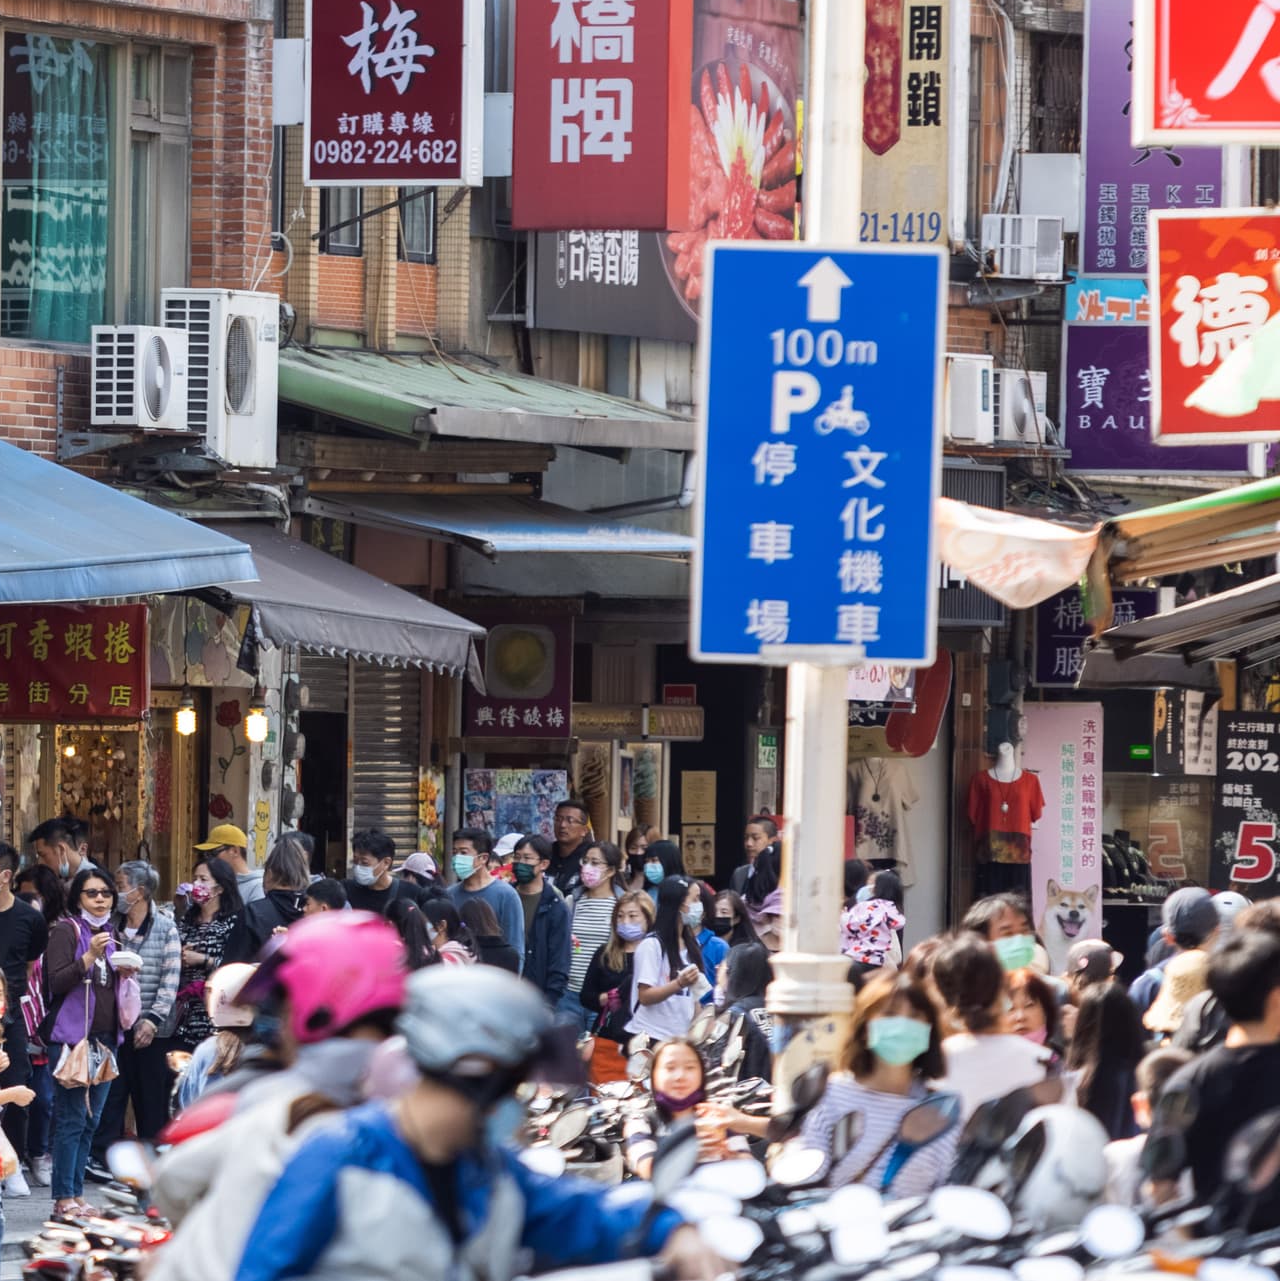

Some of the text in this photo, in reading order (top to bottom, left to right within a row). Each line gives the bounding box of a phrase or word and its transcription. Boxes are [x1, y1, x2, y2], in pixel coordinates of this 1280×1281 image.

[906, 5, 943, 127] 開鎖
[337, 111, 436, 135] 訂購專線
[770, 328, 879, 368] 100m
[772, 372, 820, 434] P
[745, 443, 798, 643] 停車場
[834, 445, 887, 647] 文化機車
[475, 705, 565, 729] 興隆酸梅
[1081, 719, 1097, 868] 洗不臭 給寵物最好的
[1229, 820, 1277, 883] 5
